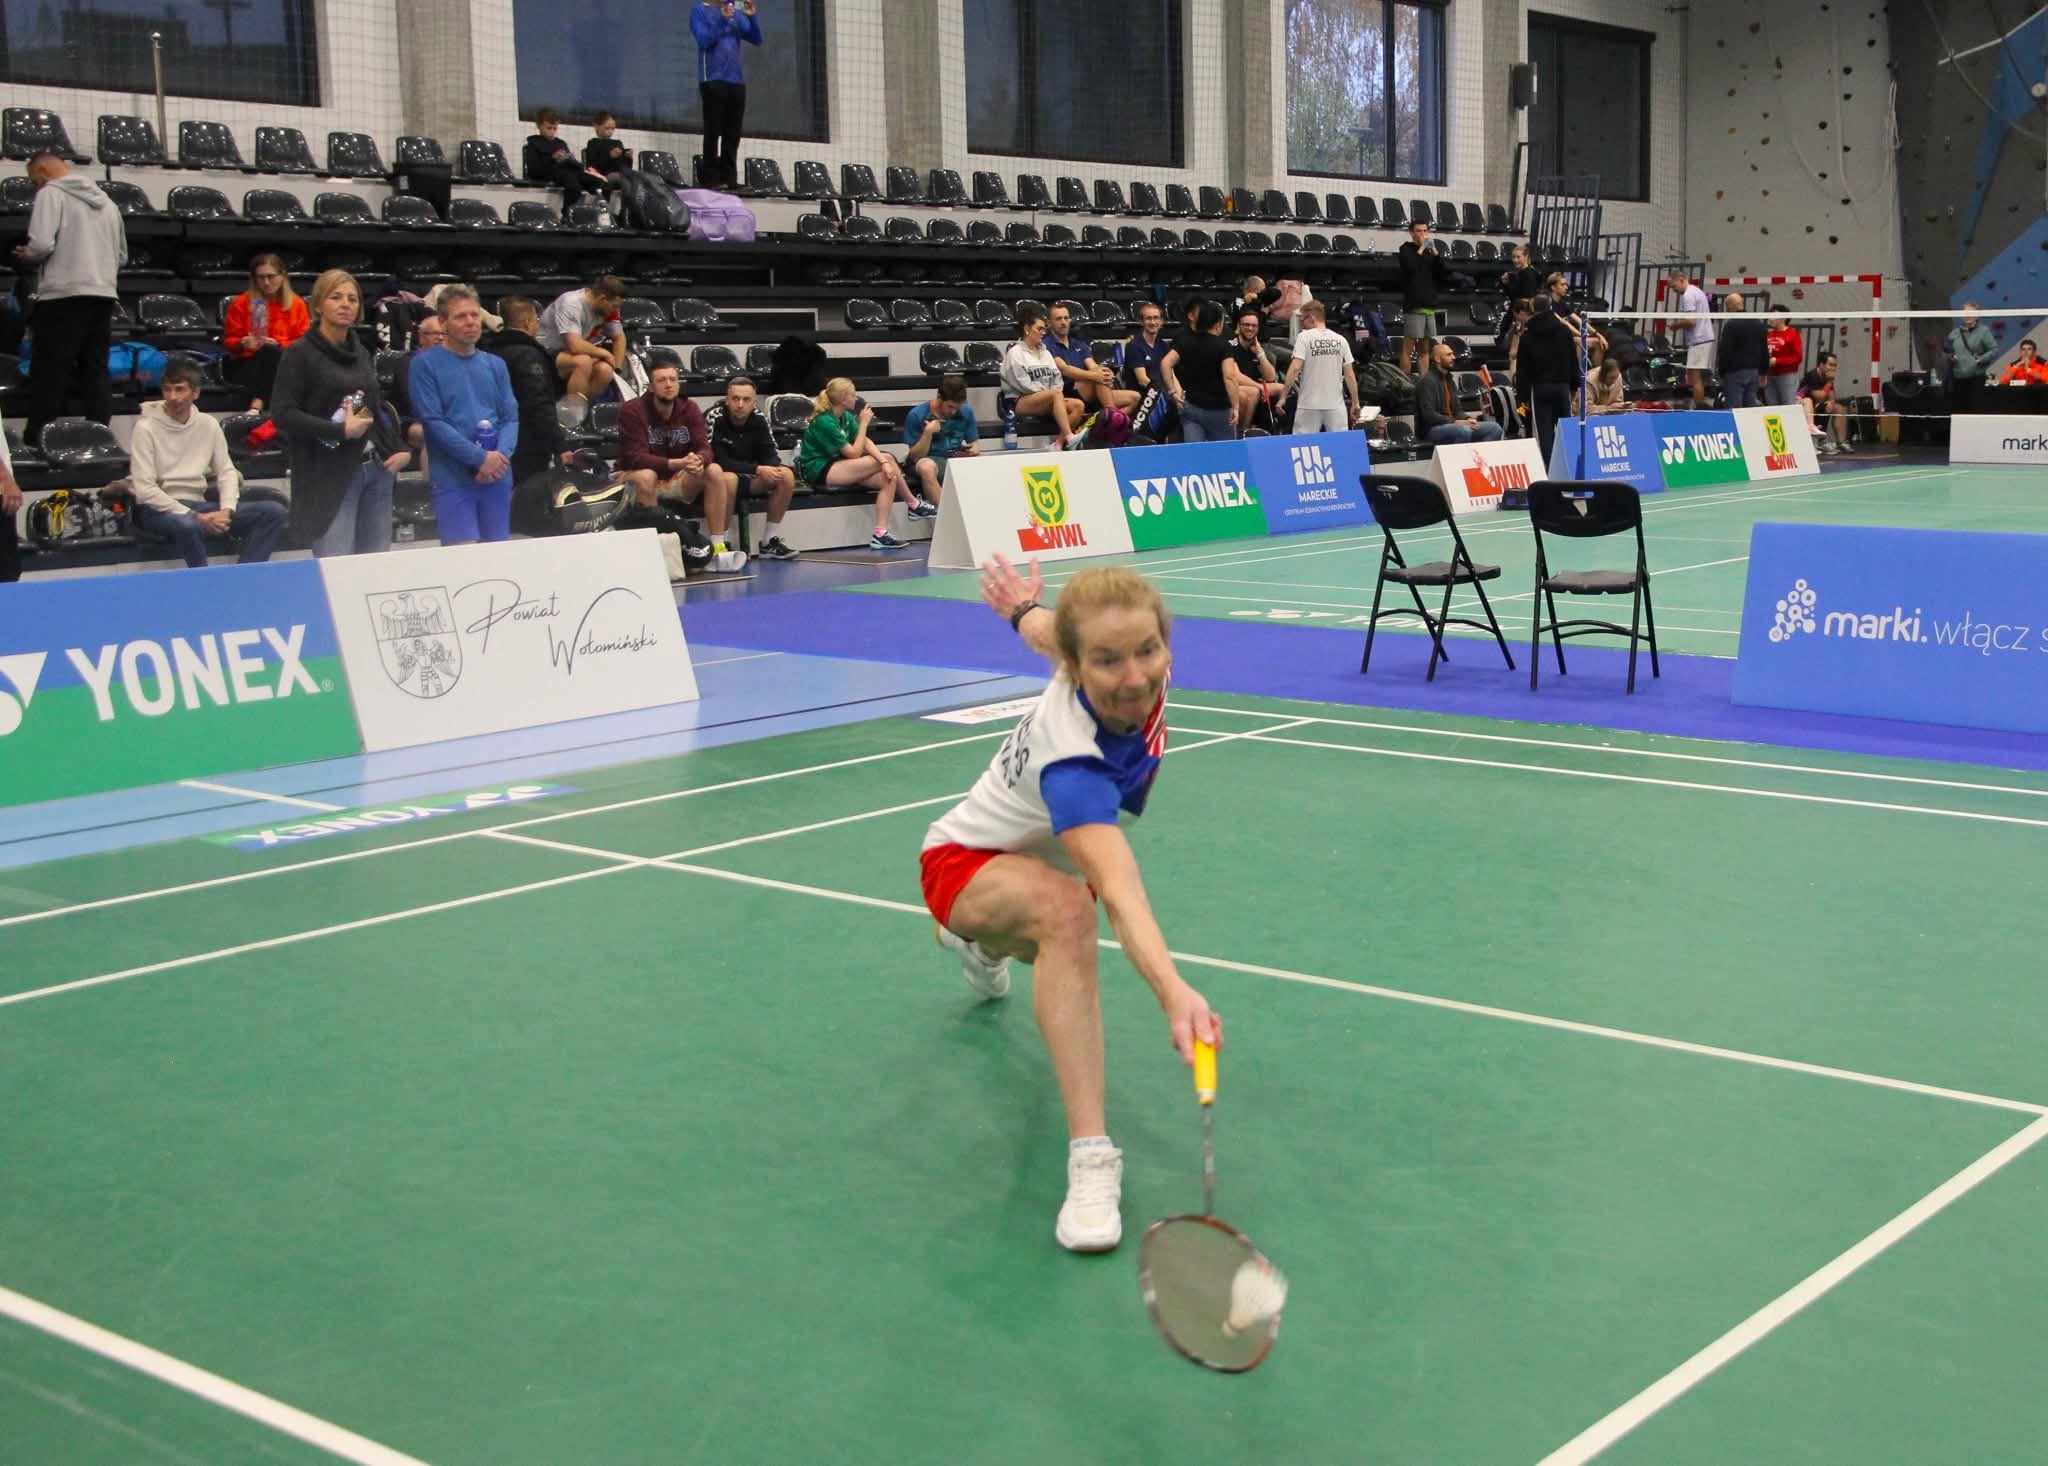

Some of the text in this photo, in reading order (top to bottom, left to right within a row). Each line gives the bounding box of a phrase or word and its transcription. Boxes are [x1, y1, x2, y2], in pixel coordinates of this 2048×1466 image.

[1688, 433, 1740, 462] YONEX
[2002, 434, 2048, 450] mark
[1171, 471, 1254, 512] YONEX
[1298, 489, 1338, 502] MARECKIE
[453, 578, 658, 676] Powiat Wołomiński
[1823, 607, 1928, 644] marki.
[1933, 610, 2031, 657] włącz
[233, 804, 456, 846] YONEX
